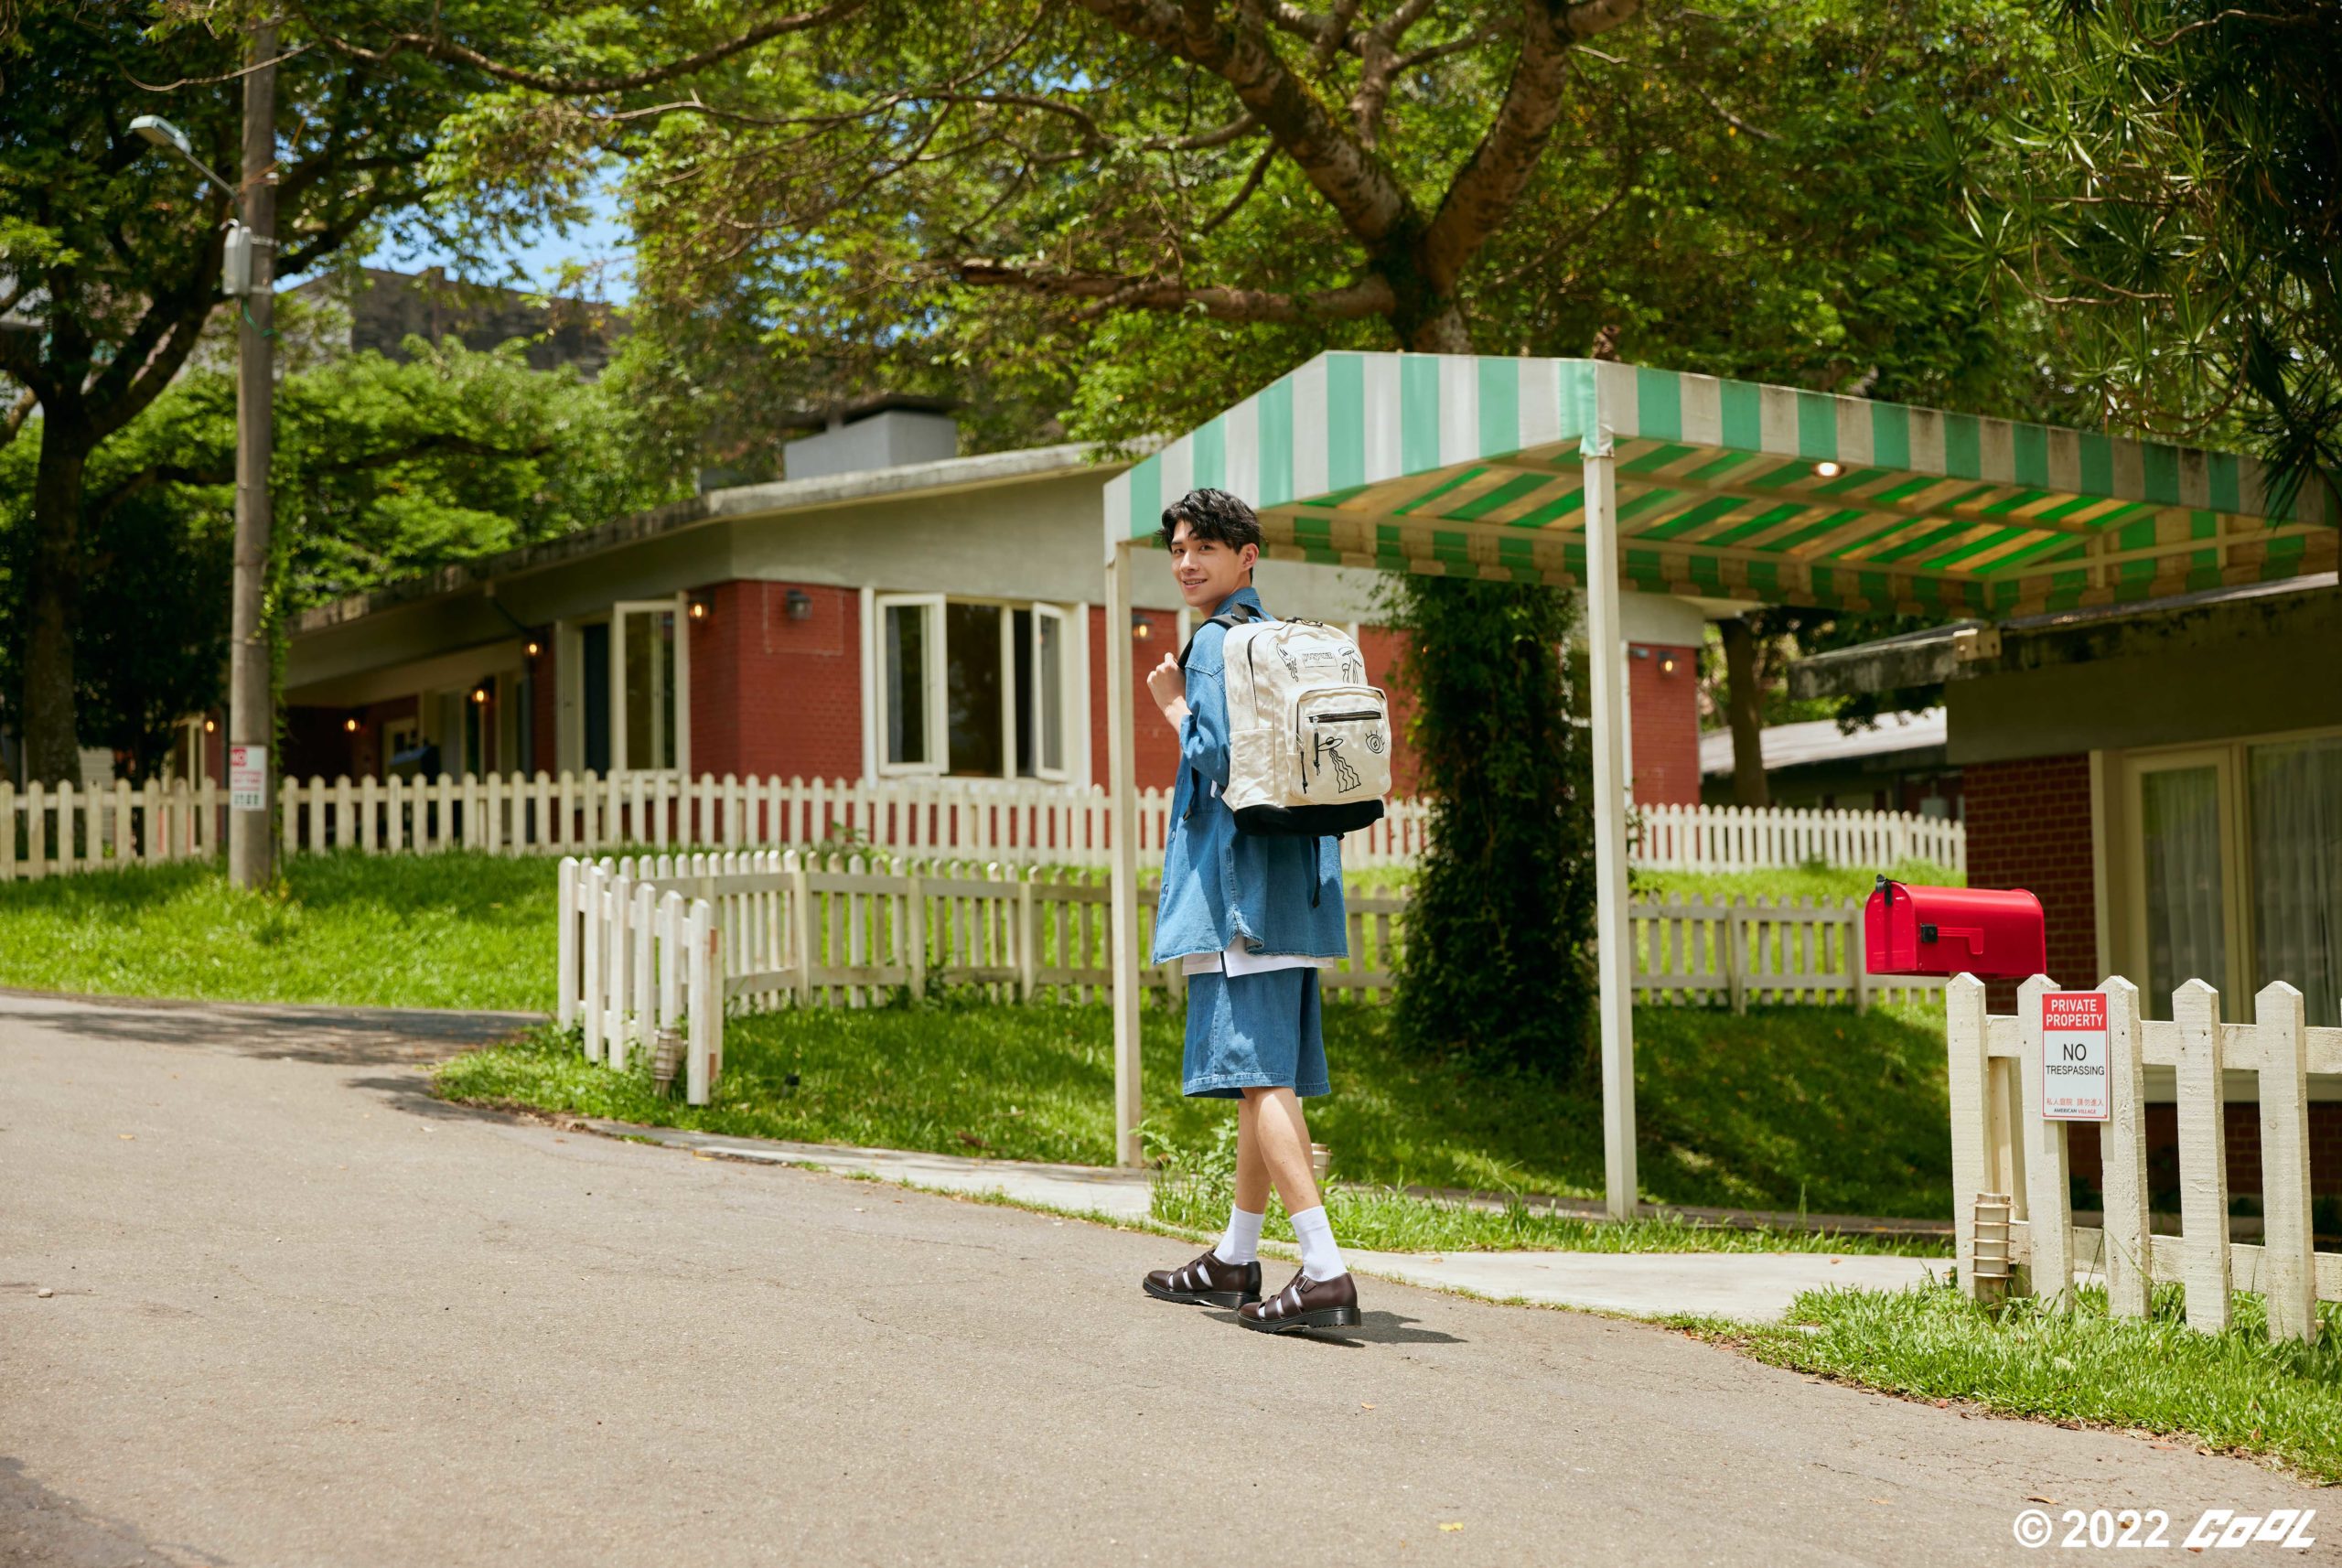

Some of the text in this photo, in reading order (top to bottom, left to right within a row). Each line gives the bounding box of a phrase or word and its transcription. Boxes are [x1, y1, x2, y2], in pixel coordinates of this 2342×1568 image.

[2051, 999, 2097, 1012] PRIVATE
[2046, 1014, 2103, 1026] PROPERTY
[2063, 1044, 2087, 1061] NO
[2046, 1065, 2105, 1076] TRESPASSING
